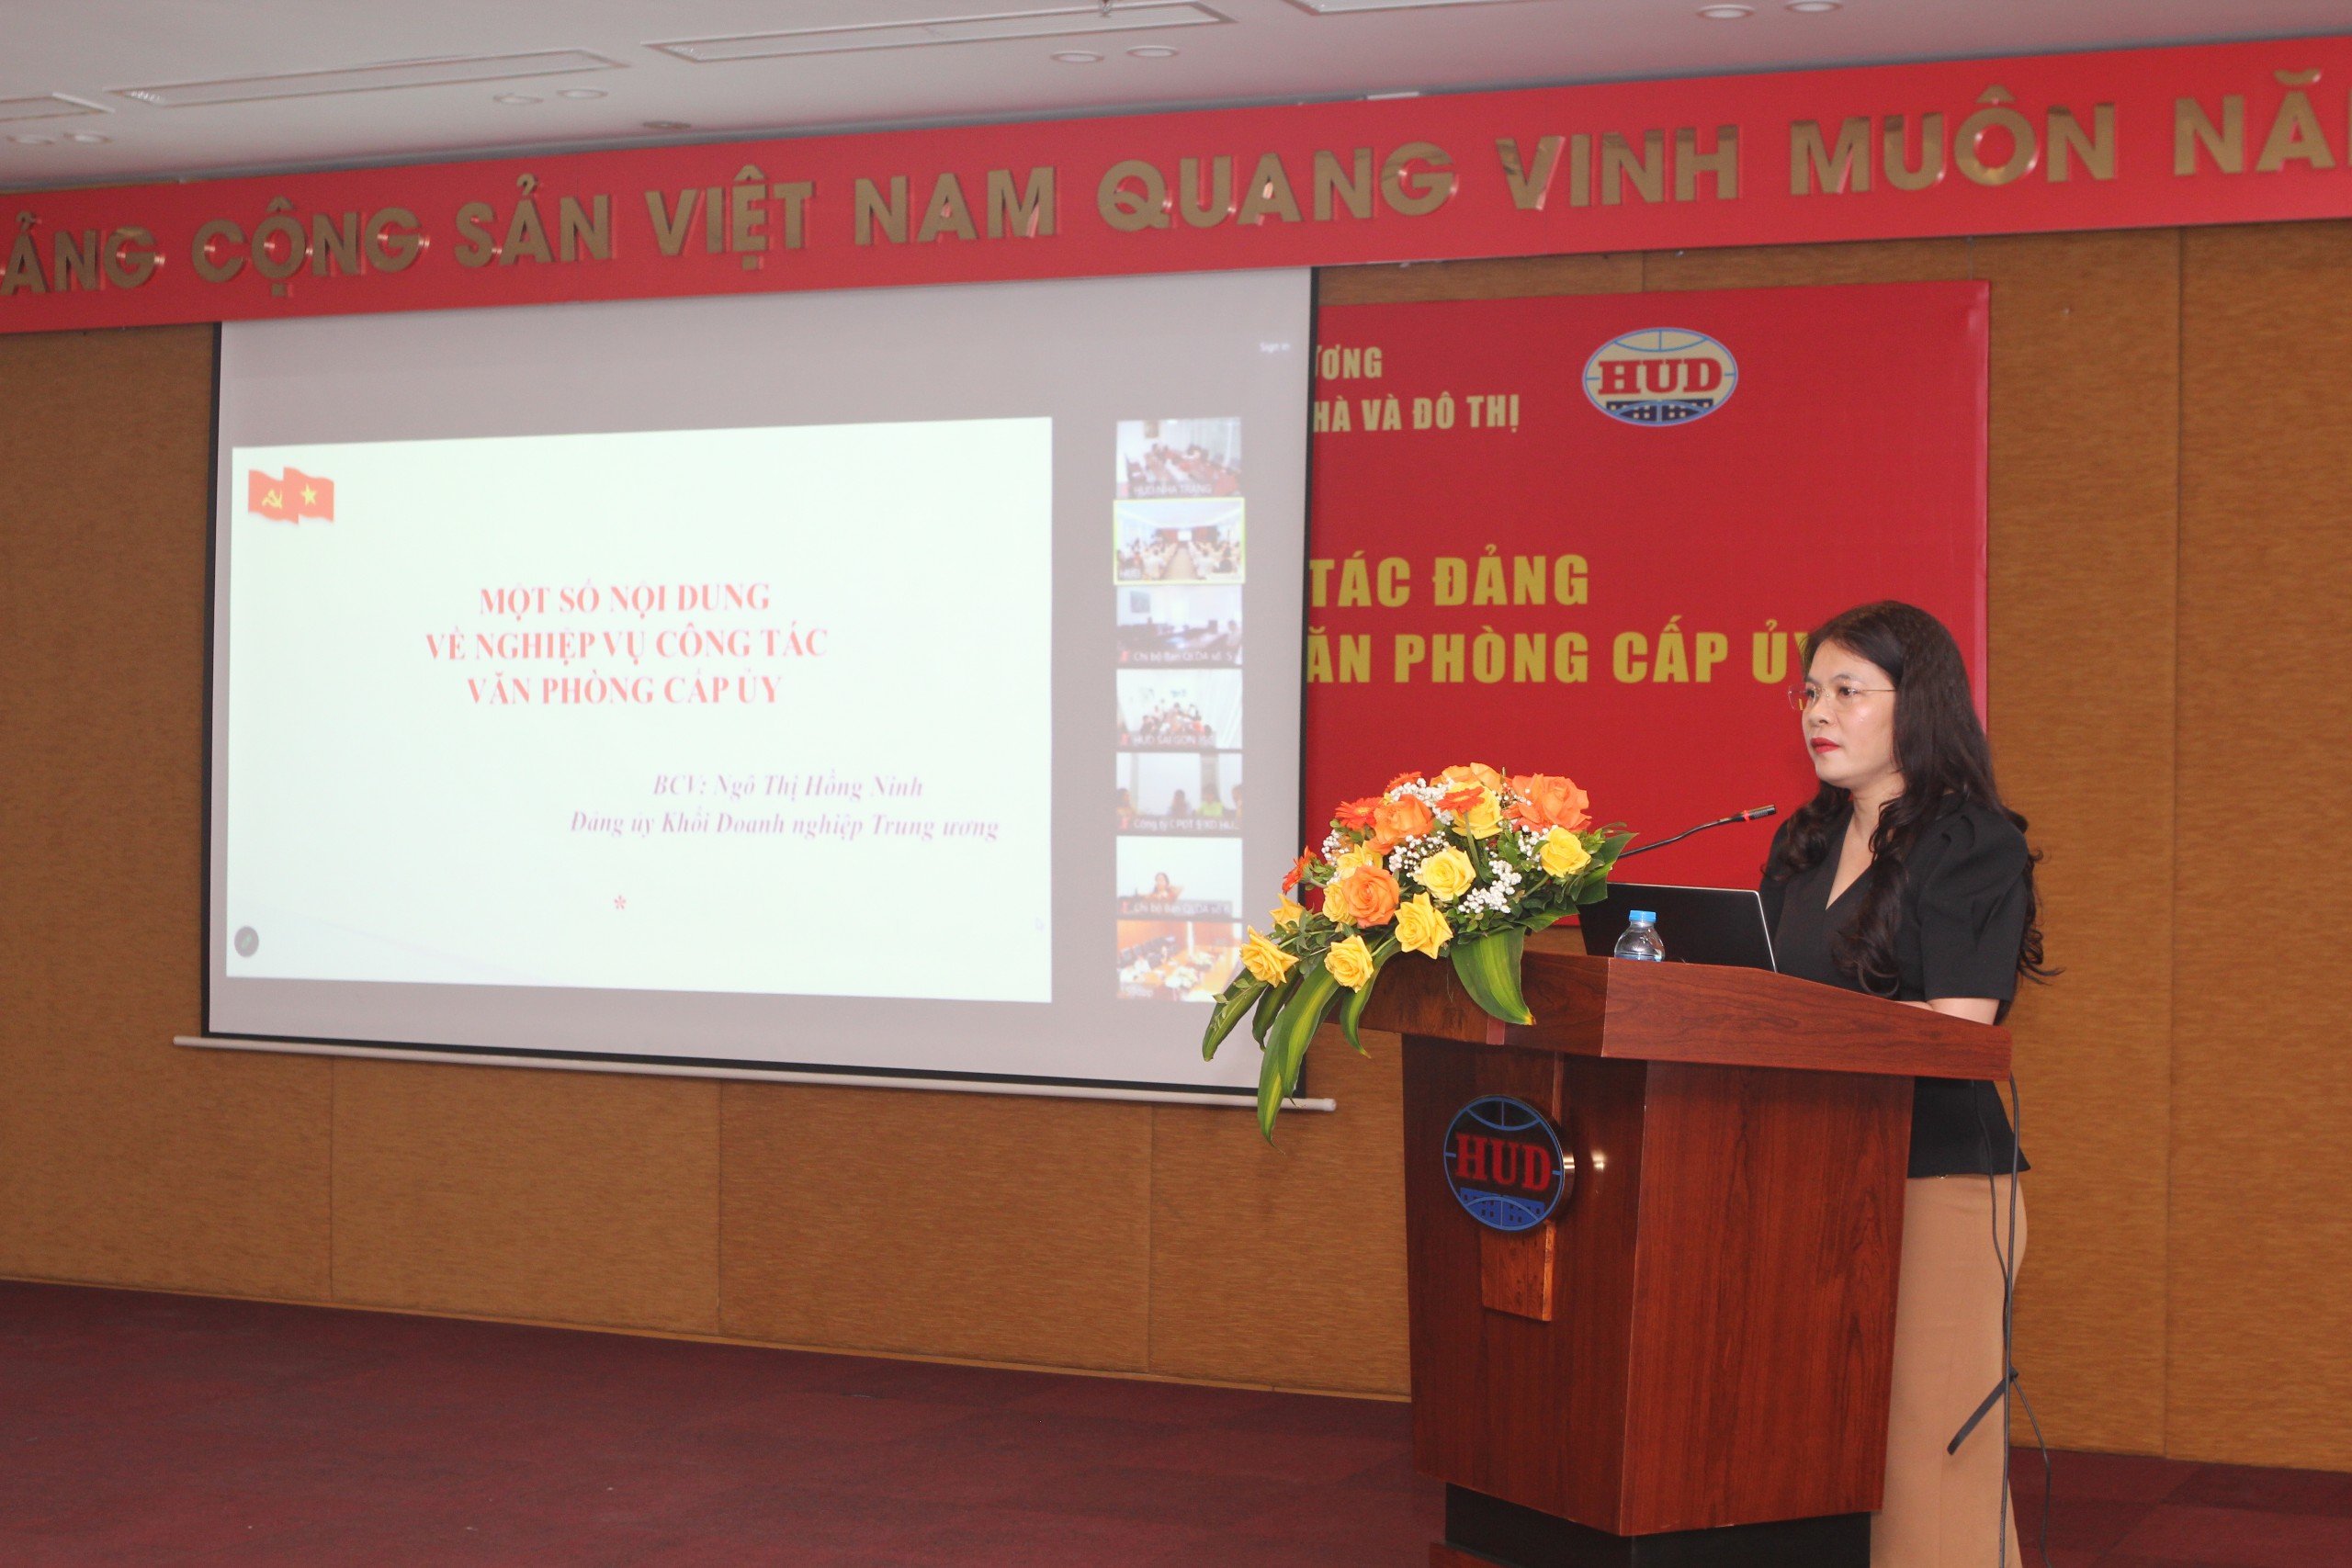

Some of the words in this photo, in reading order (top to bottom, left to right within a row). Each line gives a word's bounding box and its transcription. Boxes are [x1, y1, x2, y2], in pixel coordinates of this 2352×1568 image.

[191, 196, 423, 297] CỘNG
[454, 175, 612, 268] SẢN
[645, 164, 813, 270] VIỆT
[854, 165, 1057, 246] NAM
[1098, 141, 1457, 231] QUANG
[1495, 124, 1739, 210] VINH
[1790, 85, 2117, 197] MUÔN
[2174, 68, 2352, 175] NĂ
[1598, 356, 1723, 396] HUD
[1361, 392, 1403, 432] VÀ
[1412, 390, 1456, 430] ĐÔ
[1466, 393, 1521, 434] THỊ
[1308, 551, 1411, 608] TÁC
[1431, 544, 1589, 607] ĐẢNG
[479, 582, 551, 622] MỘT
[559, 578, 601, 614] SỐ
[610, 581, 667, 619] NỘI
[677, 582, 770, 612] DUNG
[475, 627, 596, 667] NGHIỆP
[603, 630, 645, 666] VỤ
[655, 622, 751, 659] CÔNG
[760, 620, 828, 657] TÁC
[1395, 626, 1589, 683] PHÒNG
[1612, 615, 1729, 683] CẤP
[467, 671, 531, 705] VĂN
[542, 669, 654, 705] PHÒNG
[652, 773, 707, 795] BCV:
[714, 774, 756, 801] Ngô
[764, 774, 798, 802] Thị
[805, 769, 864, 801] Hồng
[870, 774, 924, 797] Ninh
[717, 812, 786, 834] Doanh
[792, 814, 864, 841] nghiệp
[873, 814, 935, 841] Trung
[1455, 1134, 1553, 1192] HUD
